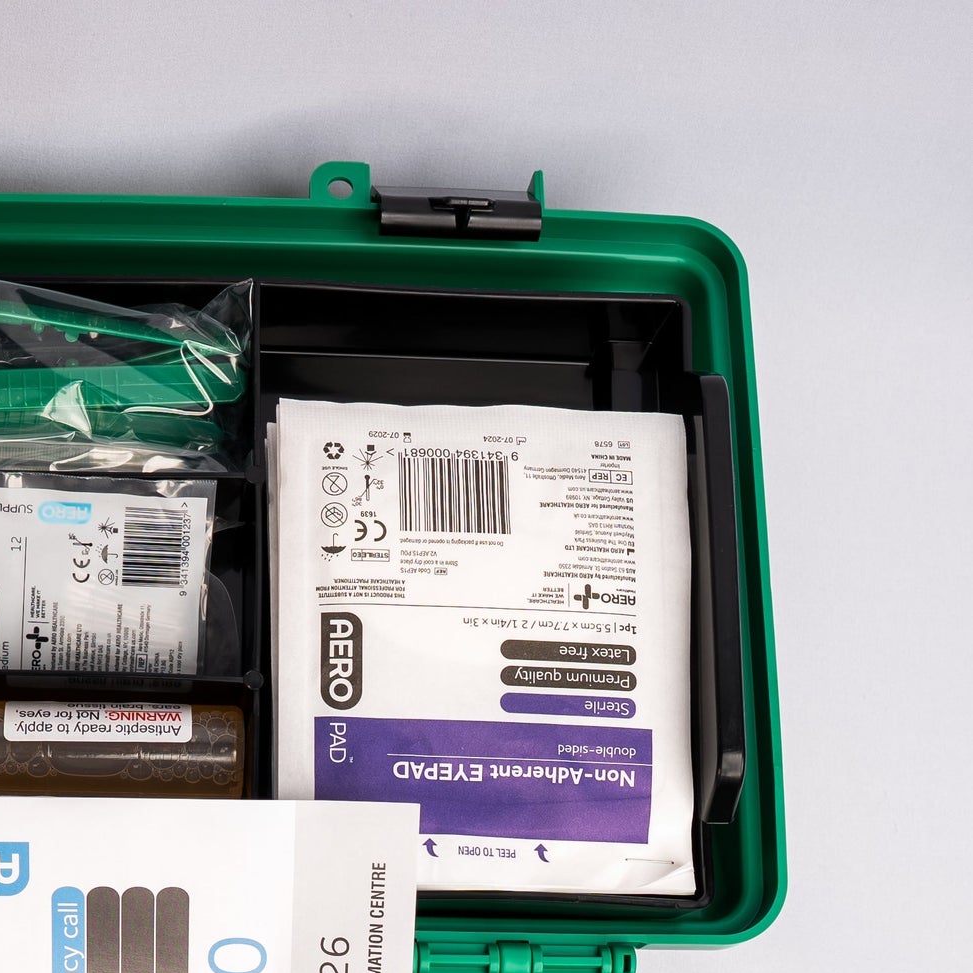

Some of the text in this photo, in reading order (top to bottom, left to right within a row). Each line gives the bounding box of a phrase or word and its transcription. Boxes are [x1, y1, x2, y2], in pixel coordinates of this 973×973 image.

[368, 431, 399, 439] 07-2029
[483, 435, 514, 443] 07-2024
[404, 448, 519, 461] 9 341394 000681
[592, 472, 627, 481] EC REP
[11, 537, 22, 551] 12
[179, 550, 190, 585] 341394
[463, 617, 479, 628] 3in
[538, 620, 570, 631] 7.7cm
[581, 622, 611, 633] 5.5cm
[619, 624, 637, 635] 1pc
[329, 619, 353, 702] AERO
[559, 646, 630, 662] Latex free
[515, 667, 630, 688] Premium quality
[55, 708, 73, 720] for
[76, 708, 100, 720] Not
[584, 700, 630, 716] Sterile
[105, 710, 183, 722] WARNING:
[15, 720, 182, 736] Antiseptic ready to apply.
[329, 722, 347, 764] PAD
[558, 744, 637, 759] double-sided
[393, 761, 636, 788] Non-Adherent EYEPAD
[459, 846, 517, 859] PEEL TO OPEN
[370, 862, 387, 919] CENTRE
[57, 902, 79, 938] call
